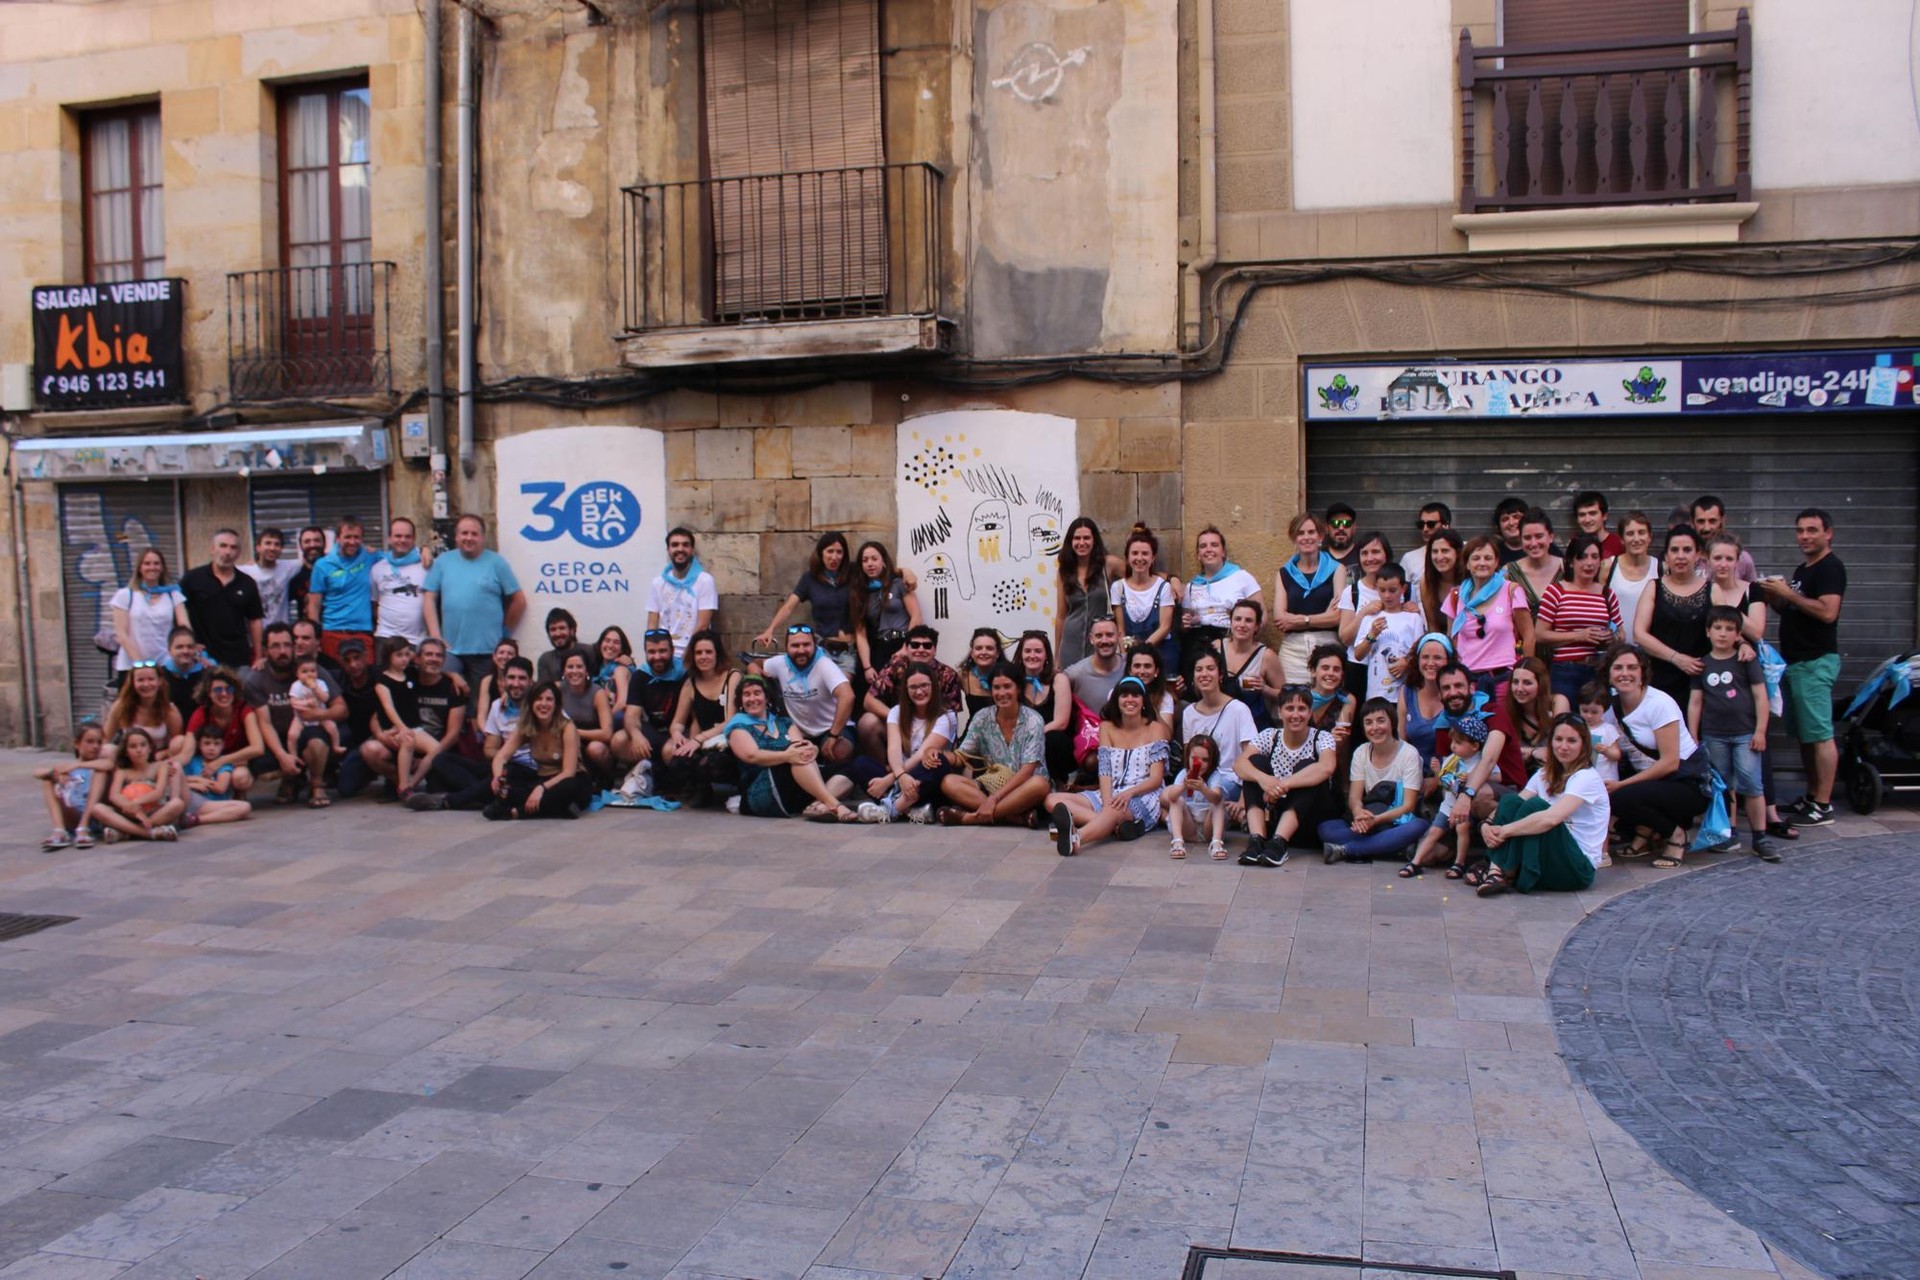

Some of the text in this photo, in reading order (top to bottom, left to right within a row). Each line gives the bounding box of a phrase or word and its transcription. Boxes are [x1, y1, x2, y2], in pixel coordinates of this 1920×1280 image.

[35, 287, 97, 310] SALGAI
[110, 281, 170, 304] VENDE
[58, 369, 165, 394] 946 123 541
[1440, 367, 1562, 386] URANGO
[541, 561, 622, 576] GEROA
[535, 578, 629, 594] ALDEAN
